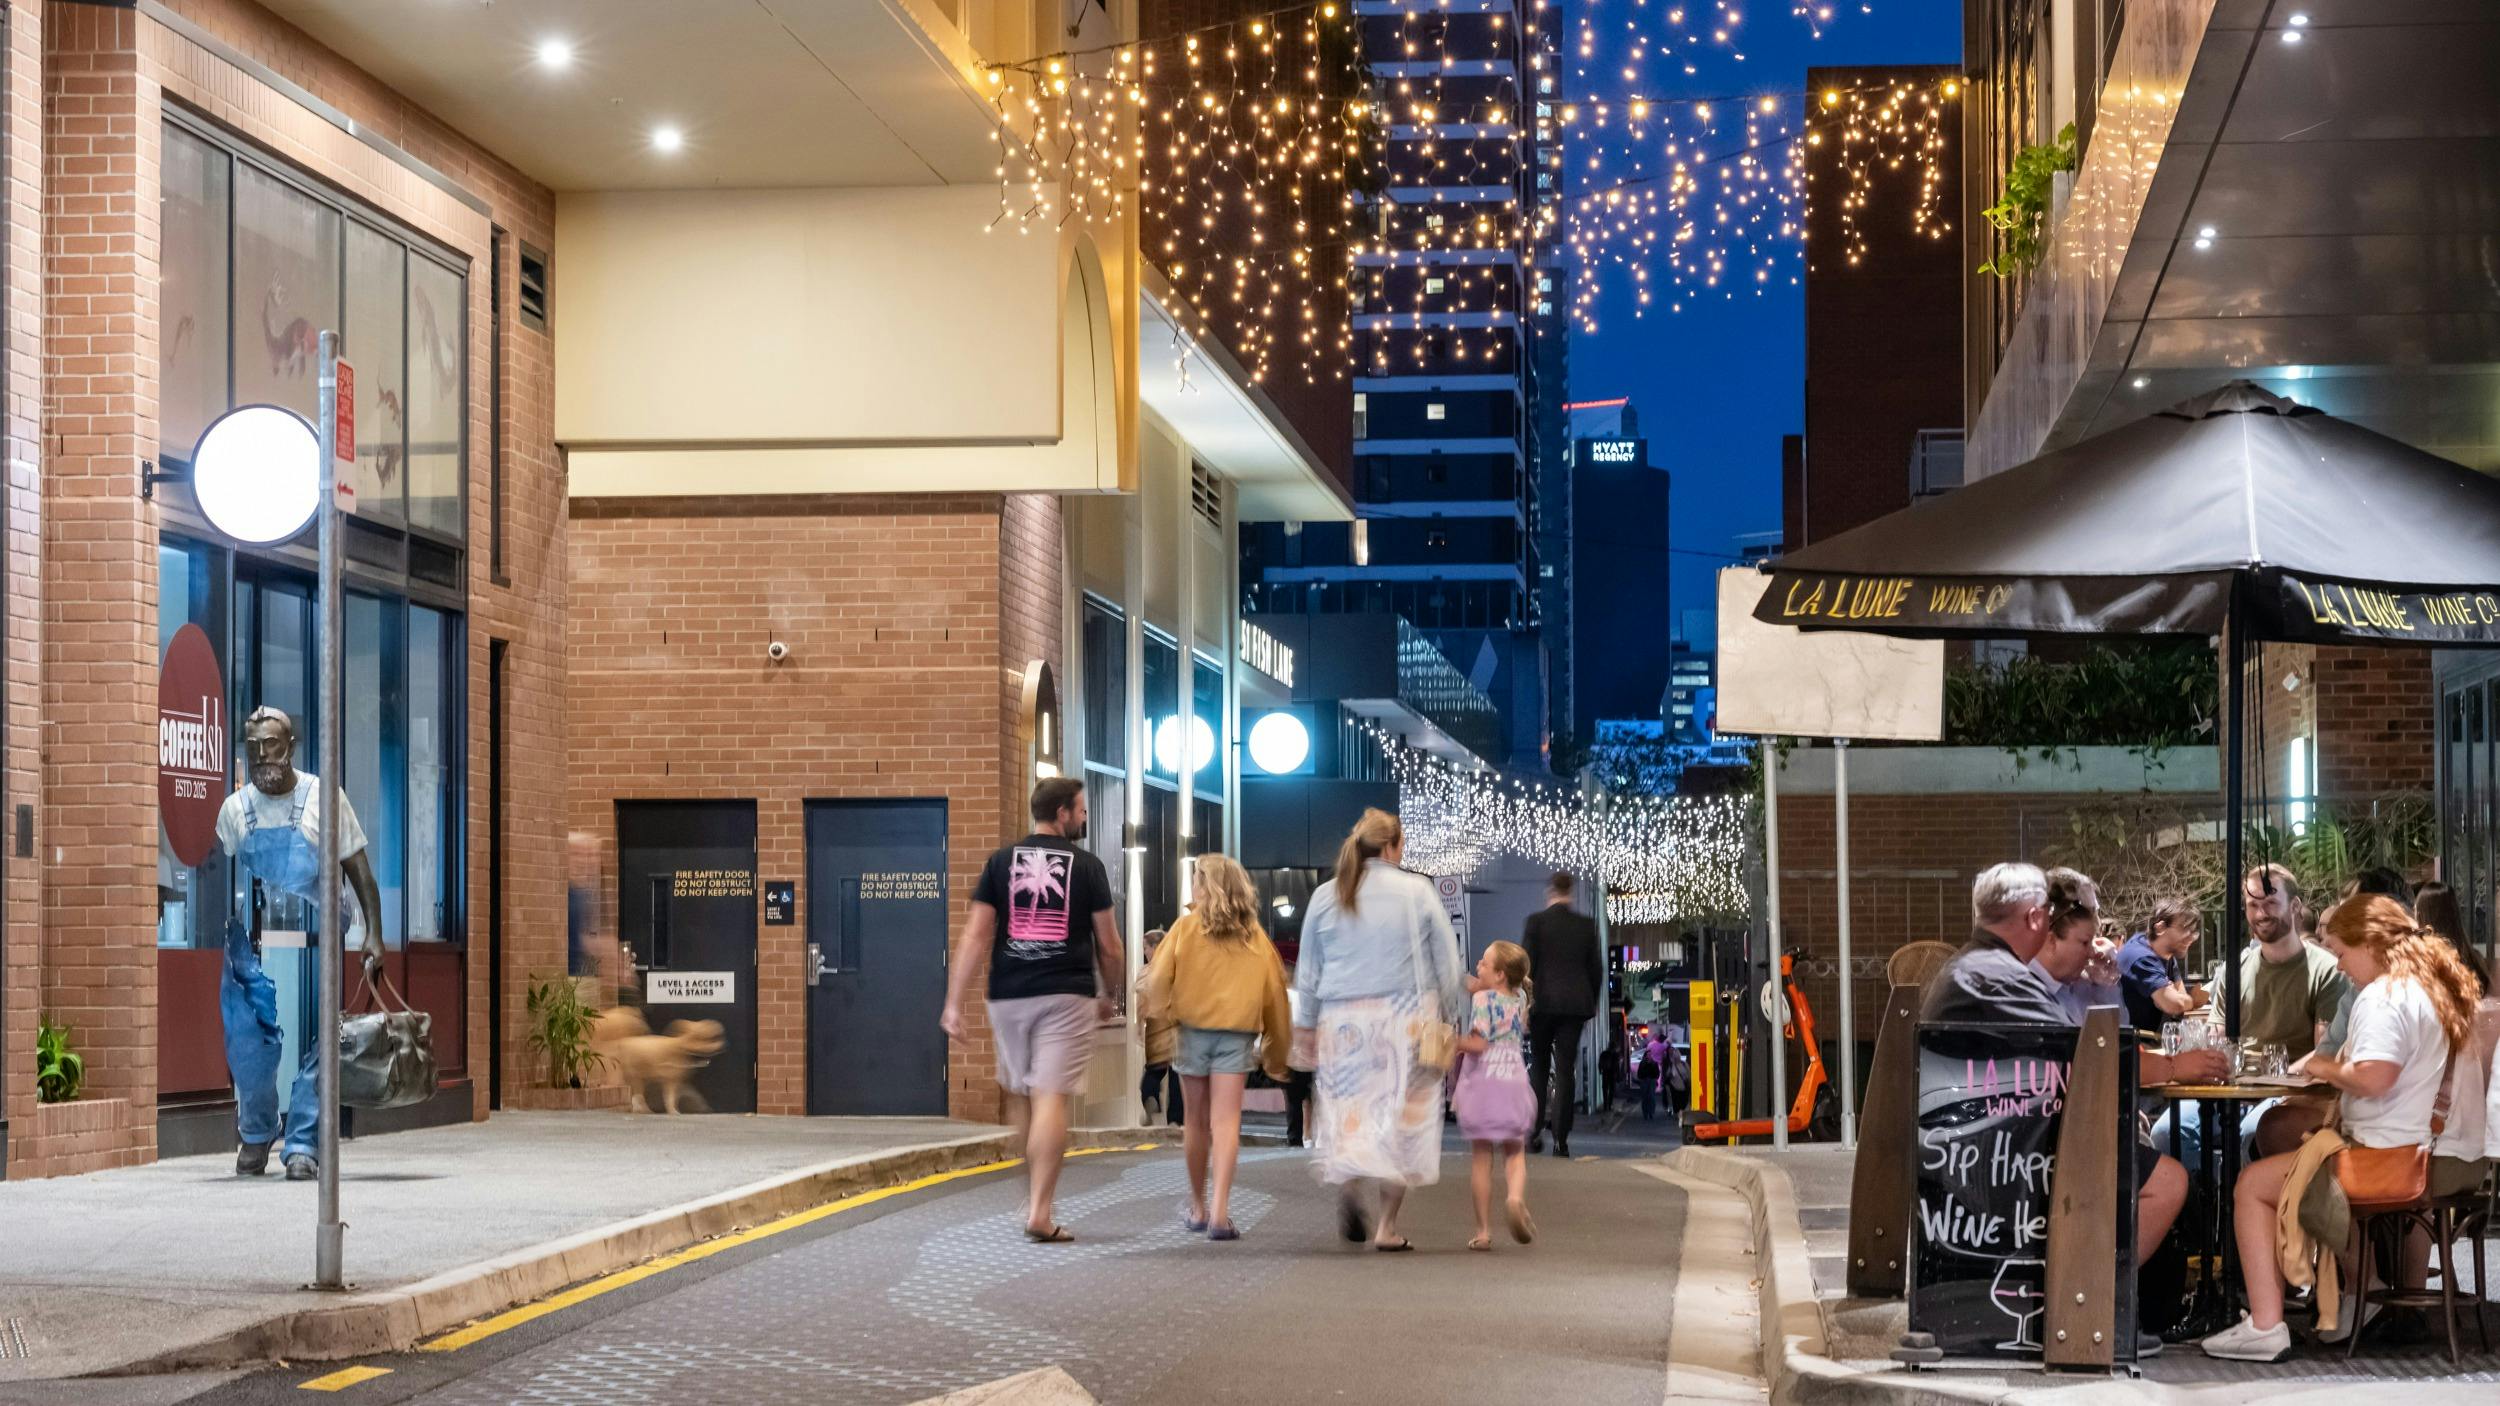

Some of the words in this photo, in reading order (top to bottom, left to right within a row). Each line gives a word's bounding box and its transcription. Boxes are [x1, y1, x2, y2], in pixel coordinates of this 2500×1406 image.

[1593, 442, 1635, 453] HYATT
[1593, 452, 1635, 462] REGENCY
[1783, 578, 1826, 617] LA
[1828, 577, 1914, 619] LUNE
[1929, 584, 1985, 615] WINE
[2300, 582, 2347, 625] LA
[2339, 585, 2415, 631] LUNE
[2422, 596, 2477, 626] WINE
[1252, 624, 1271, 677] FISH
[1273, 639, 1294, 689] LANE
[175, 778, 192, 798] ESTD
[675, 870, 693, 879] FIRE
[694, 870, 724, 879] SAFETY
[724, 870, 751, 879] DOOR
[862, 872, 879, 881] FIRE
[881, 872, 910, 881] SAFETY
[911, 872, 938, 881] DOOR
[674, 879, 688, 888] DO
[689, 879, 707, 888] NOT
[708, 879, 752, 888] OBSTRUCT
[861, 881, 874, 890] DO
[876, 881, 894, 890] NOT
[895, 881, 938, 890] OBSTRUCT
[673, 888, 687, 897] DO
[689, 888, 707, 897] NOT
[708, 888, 728, 897] KEEP
[729, 888, 753, 897] OPEN
[860, 890, 874, 899] DO
[875, 890, 893, 899] NOT
[894, 890, 915, 899] KEEP
[916, 890, 940, 899] OPEN
[657, 980, 683, 988] LEVEL
[685, 980, 690, 988] 2
[691, 980, 725, 988] ACCESS
[668, 989, 684, 997] VIA
[685, 989, 714, 997] STAIRS
[2014, 1060, 2072, 1098] LUN
[1986, 1098, 2034, 1118] WINE
[2014, 1200, 2048, 1249] He
